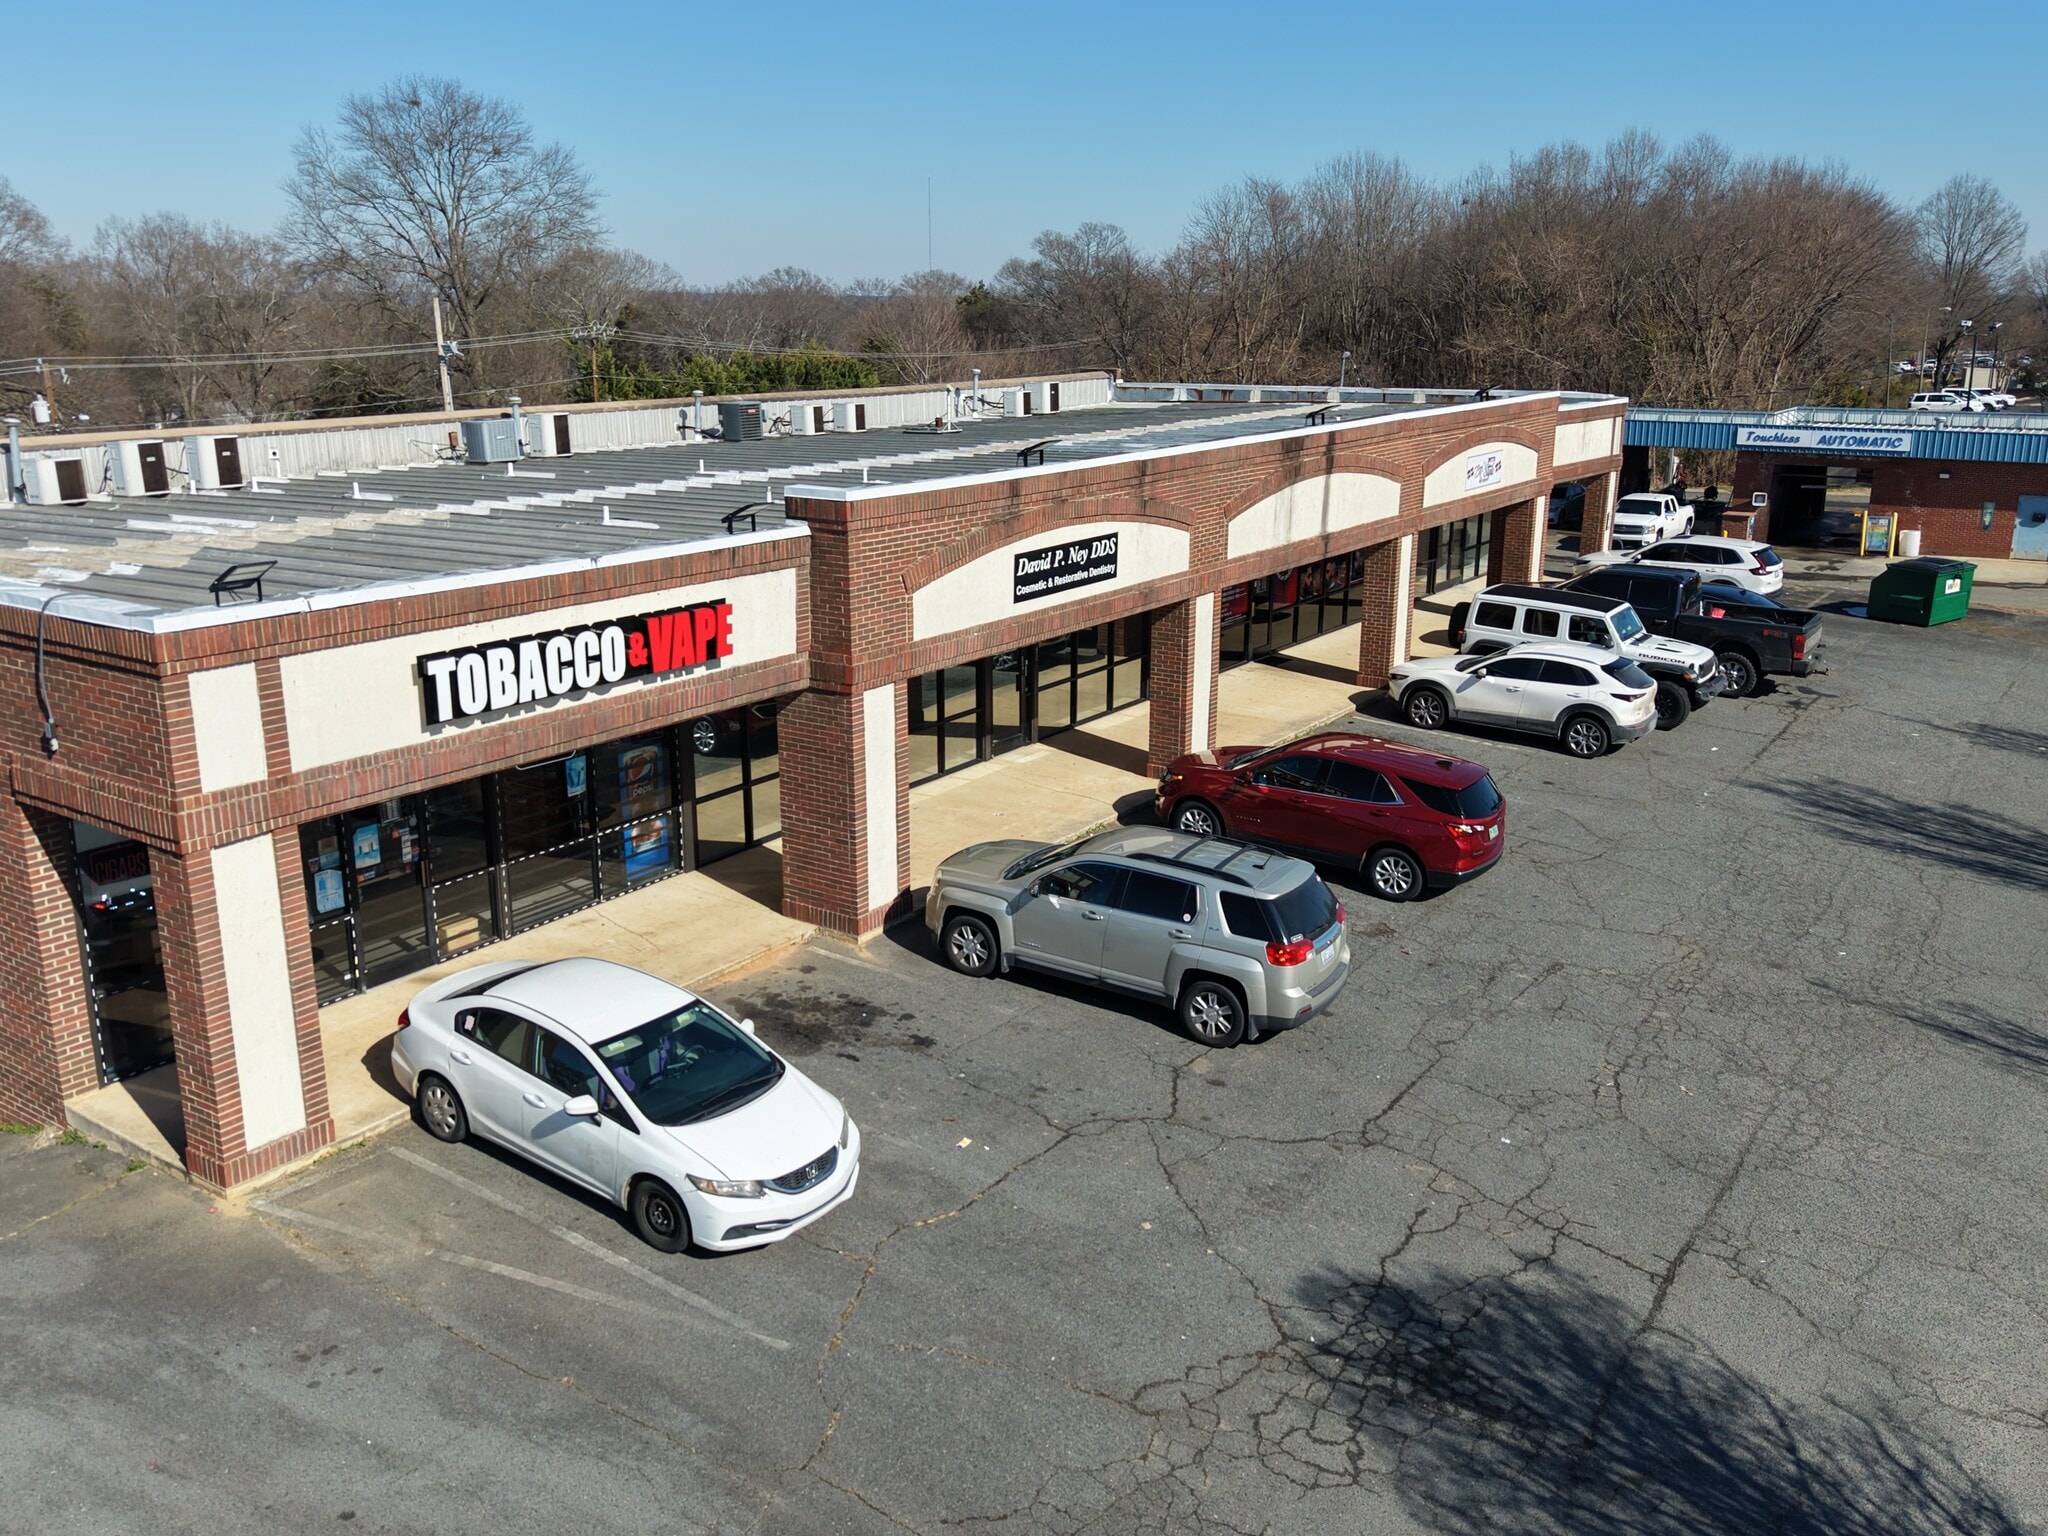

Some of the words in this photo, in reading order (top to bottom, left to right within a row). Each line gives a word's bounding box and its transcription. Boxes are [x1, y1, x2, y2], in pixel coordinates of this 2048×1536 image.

[1745, 431, 1801, 444] Touchless
[1816, 434, 1904, 449] AUTOMATIC
[1016, 552, 1052, 576] David
[1053, 550, 1065, 566] P.
[1068, 546, 1088, 565] Ney
[1090, 537, 1117, 559] DDS
[1016, 580, 1047, 596] Cosmetic
[1048, 578, 1054, 588] &
[1054, 570, 1089, 586] Restorative
[1089, 563, 1116, 577] Dentistry
[426, 626, 627, 723] TOBACCO
[645, 603, 734, 674] VAPE
[1638, 652, 1686, 665] RUBICON
[633, 783, 654, 798] pepsi
[95, 852, 147, 884] CIGARS
